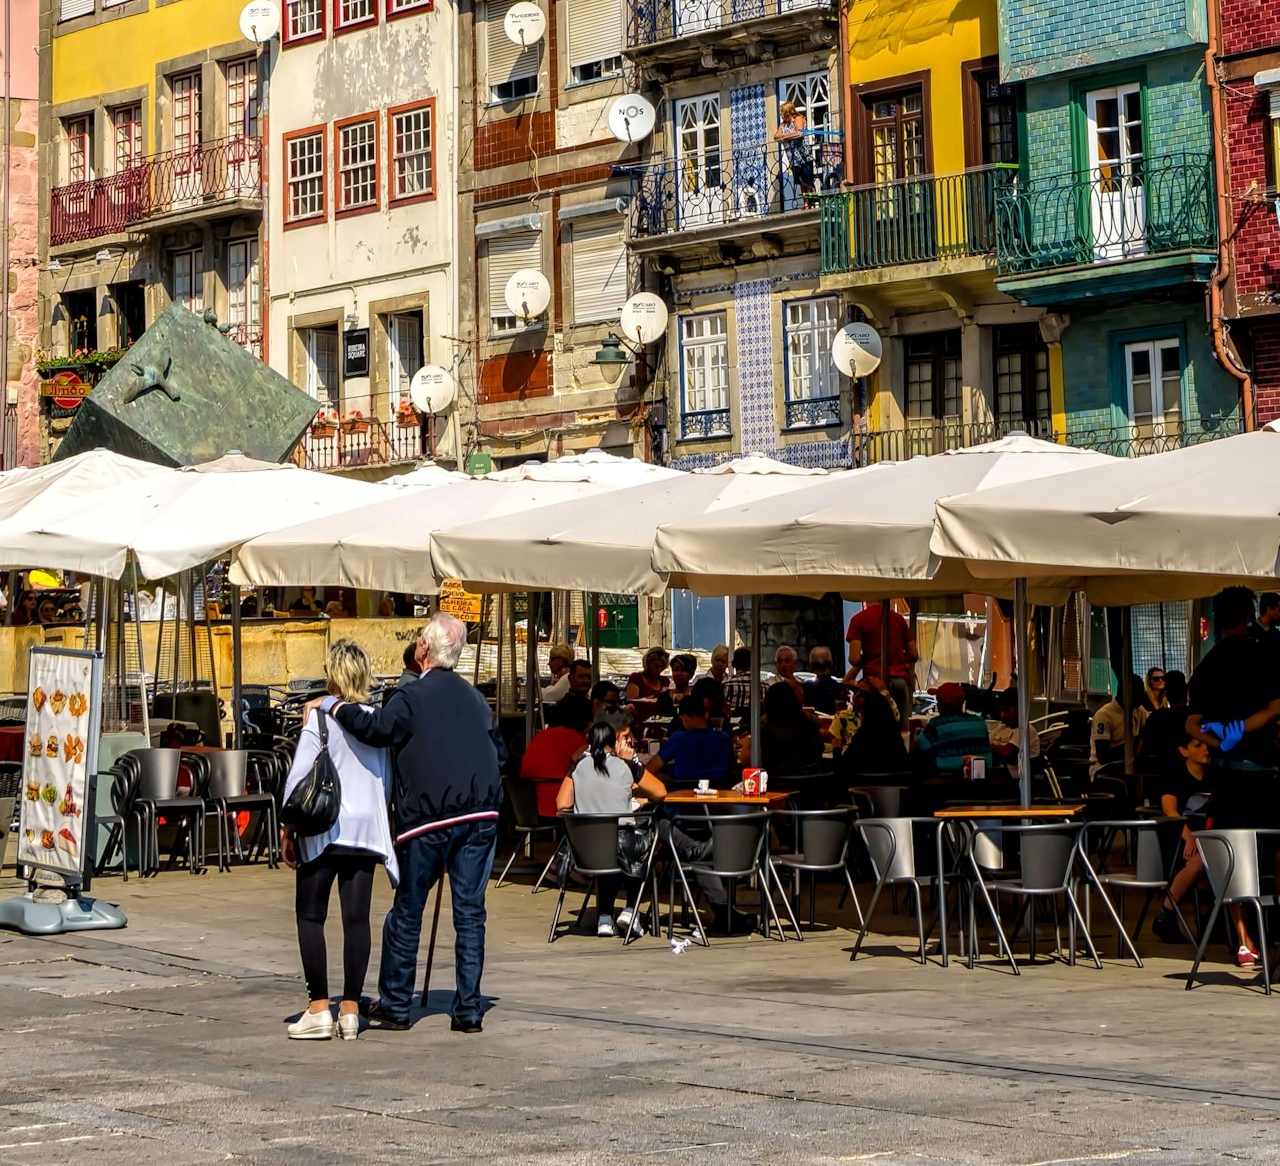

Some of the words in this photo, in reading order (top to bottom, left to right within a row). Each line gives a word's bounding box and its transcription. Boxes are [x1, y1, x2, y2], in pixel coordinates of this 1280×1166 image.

[618, 105, 644, 118] NOS
[347, 343, 366, 352] RIBEIRA
[347, 350, 366, 360] SQUARE
[441, 599, 473, 607] ALHEIRA
